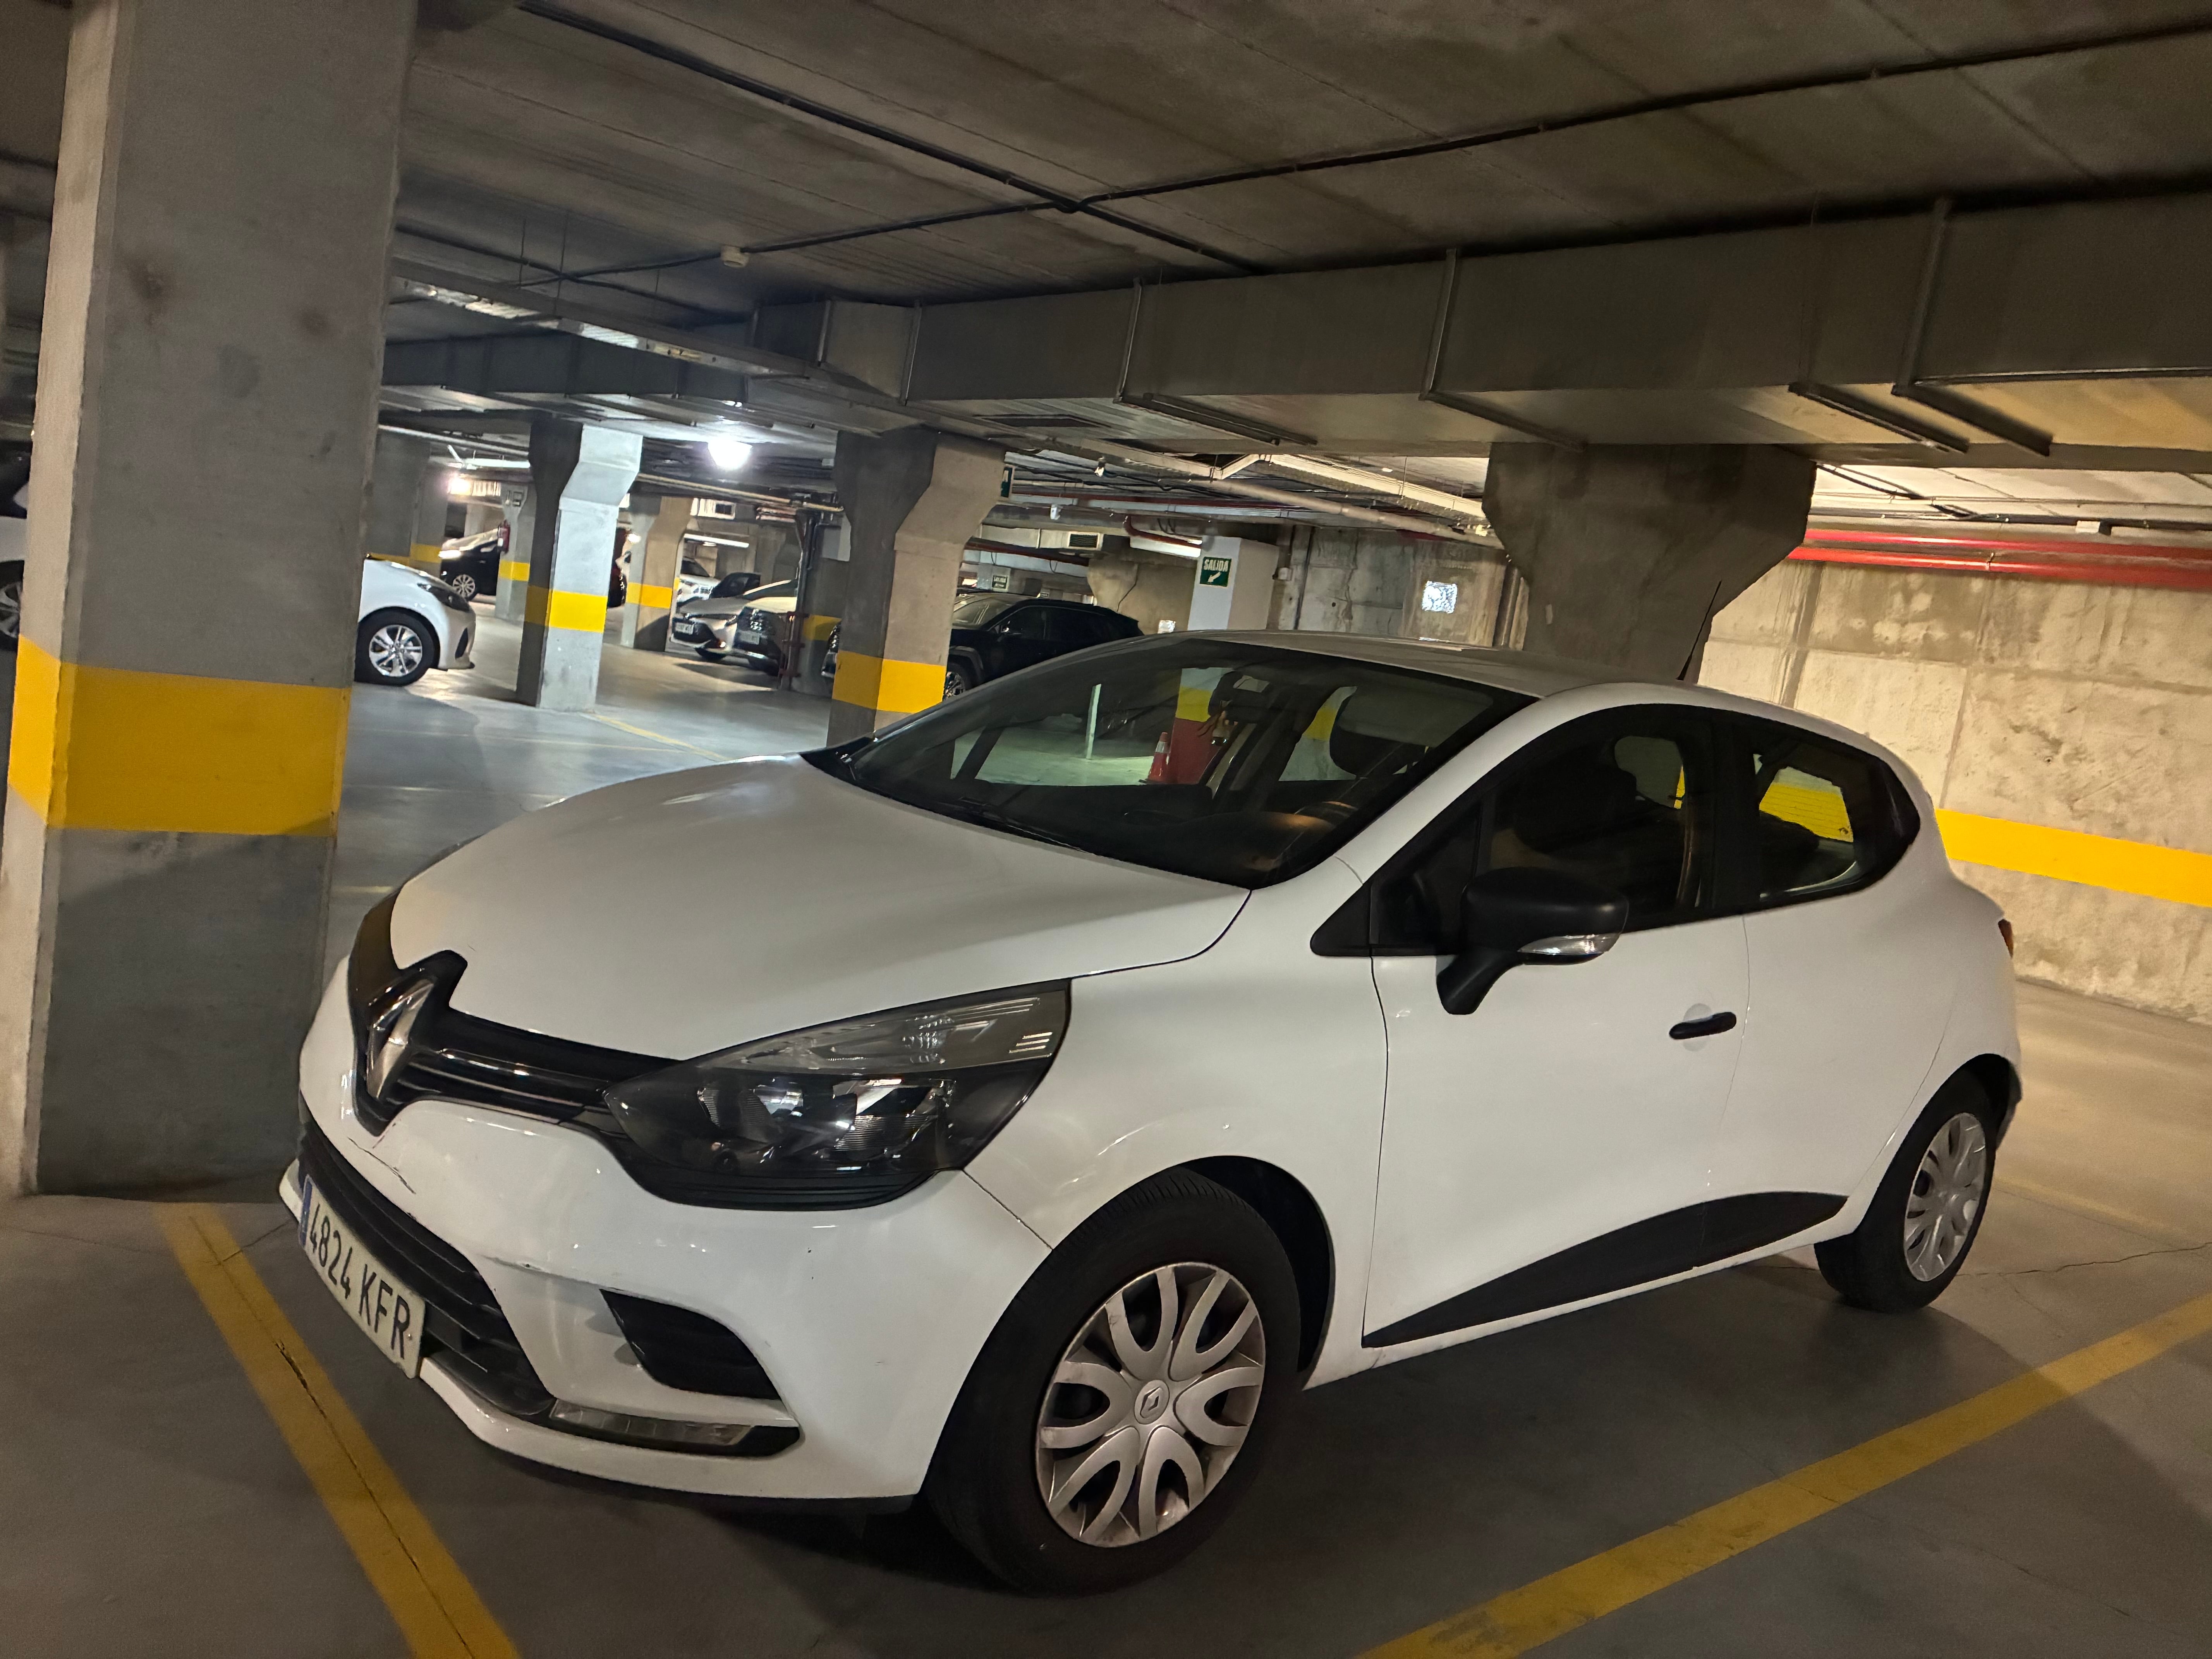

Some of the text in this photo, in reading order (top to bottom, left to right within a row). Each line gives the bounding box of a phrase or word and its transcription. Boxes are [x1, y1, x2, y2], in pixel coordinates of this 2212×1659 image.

[1204, 559, 1229, 572] SALIDA
[310, 1203, 410, 1359] 4824 KFR
